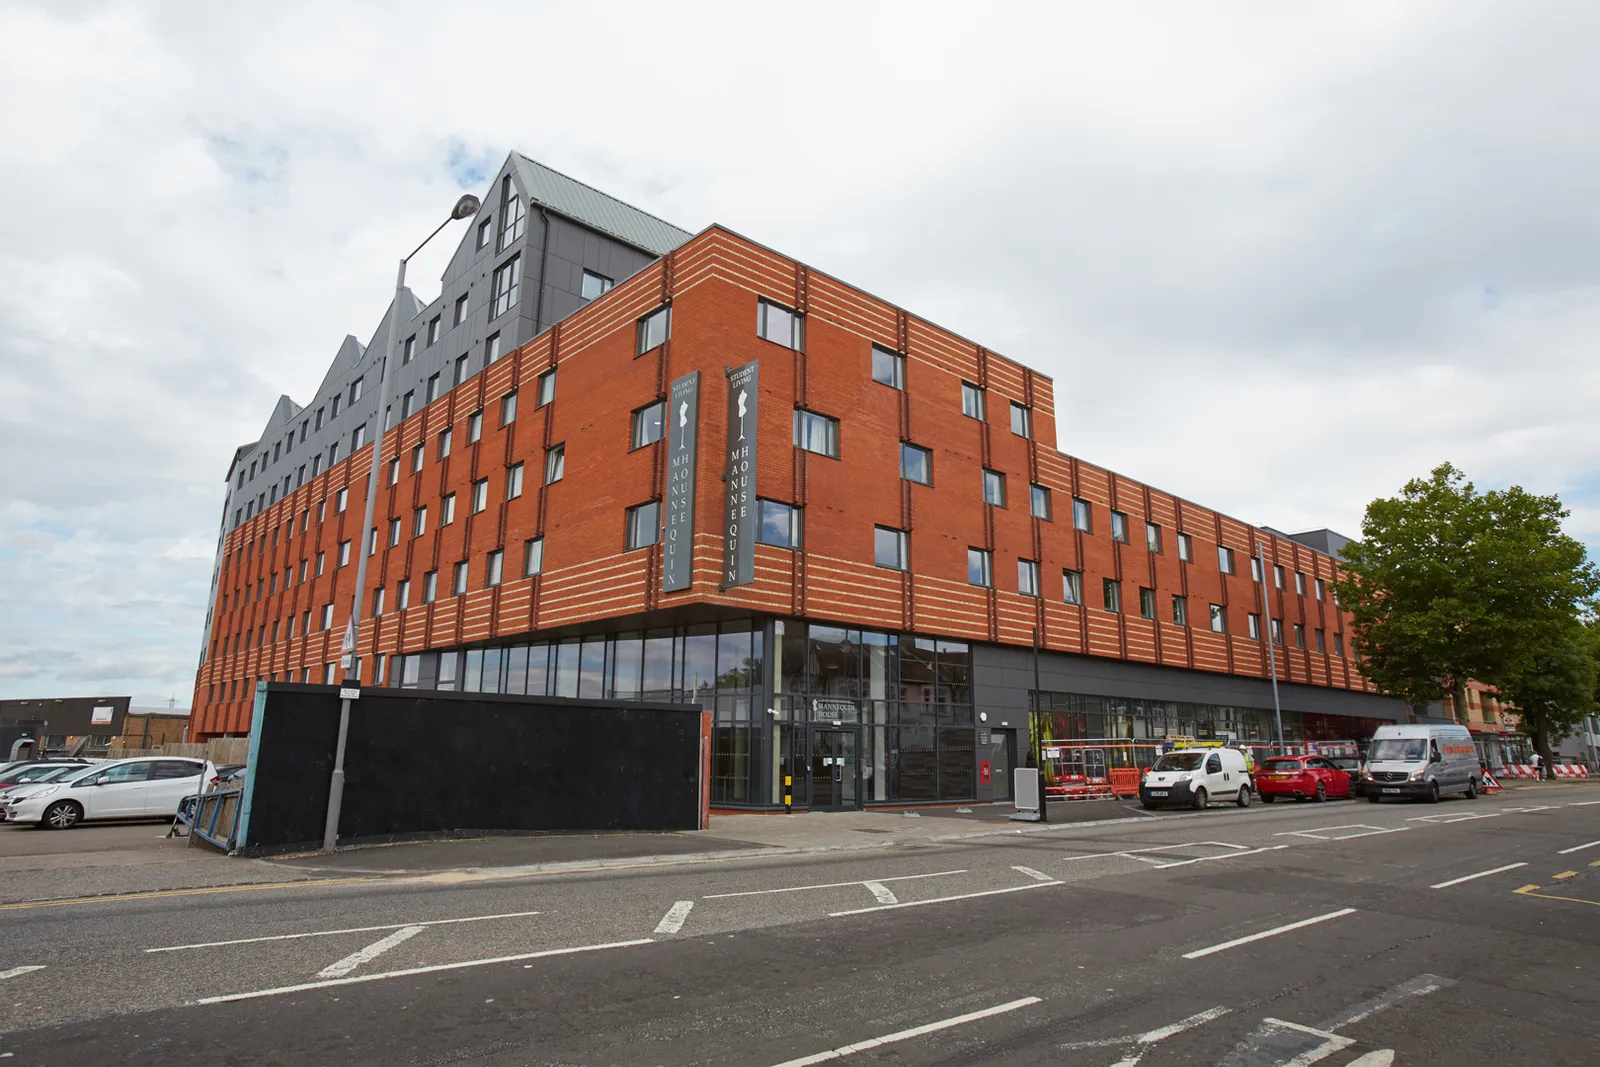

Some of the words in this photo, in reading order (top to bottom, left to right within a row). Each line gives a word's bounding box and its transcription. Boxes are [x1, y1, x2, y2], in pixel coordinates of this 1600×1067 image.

[730, 365, 755, 382] STUDENT
[732, 375, 752, 388] LIVING
[672, 377, 696, 393] STUDENT
[675, 387, 693, 399] LIVING
[680, 453, 689, 524] HOUSE
[740, 446, 749, 518] HOUSE
[667, 457, 681, 586] MANNEQUIN
[728, 450, 740, 583] MANNEQUIN
[818, 703, 856, 711] MANNEQUIN
